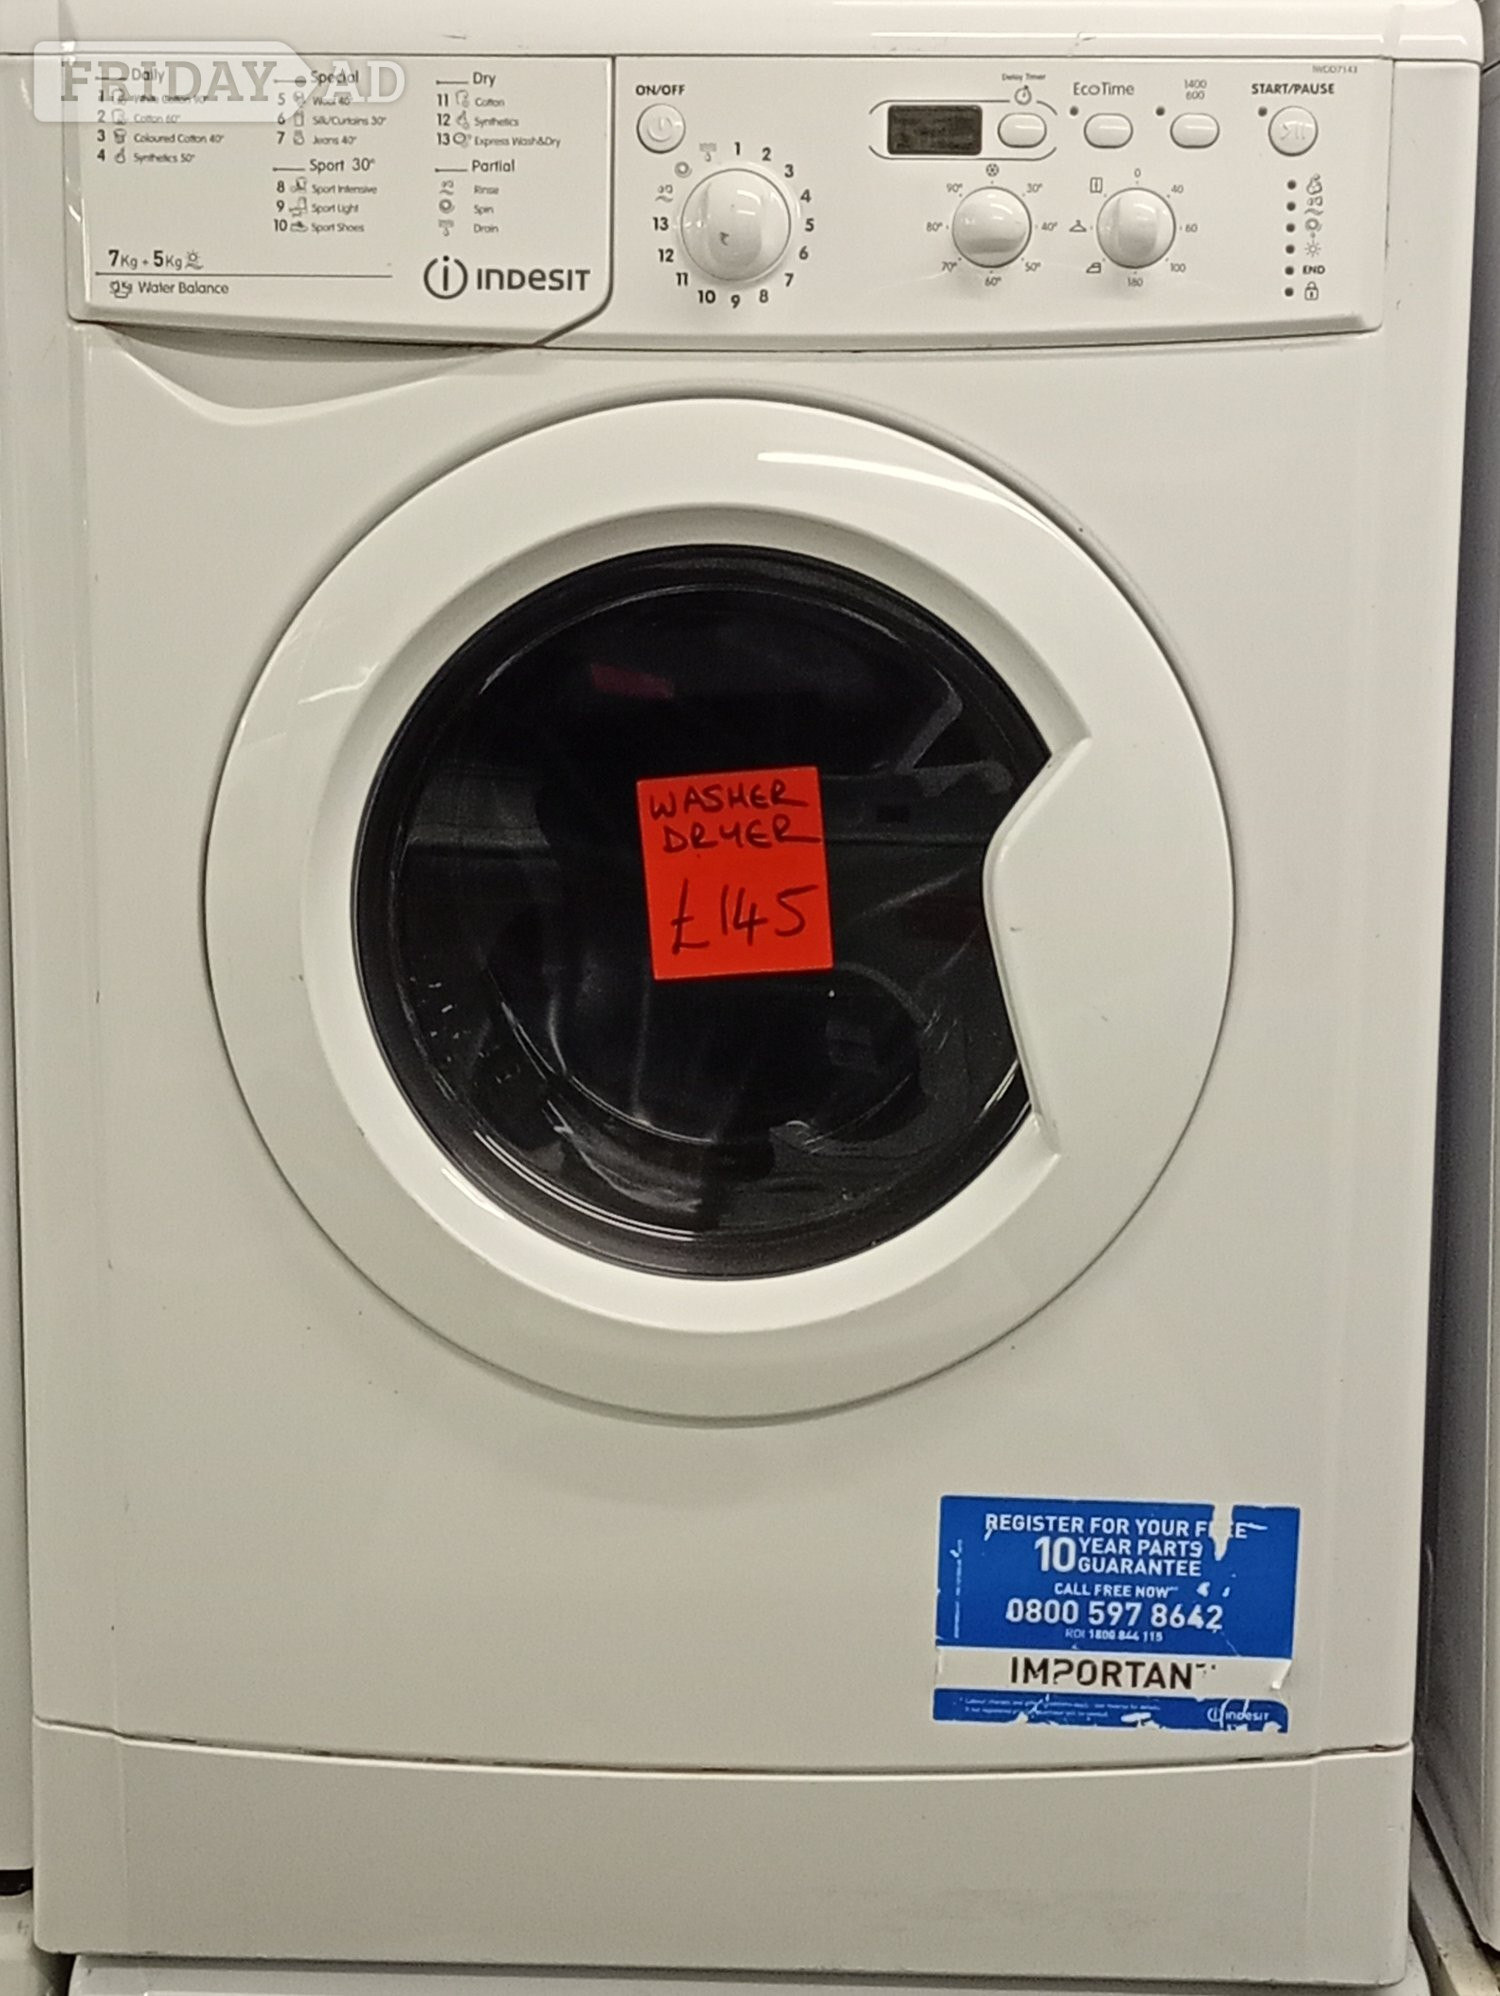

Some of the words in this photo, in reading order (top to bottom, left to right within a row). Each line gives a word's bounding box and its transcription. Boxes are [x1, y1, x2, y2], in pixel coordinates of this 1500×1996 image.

[131, 67, 165, 84] Daily
[310, 70, 359, 85] Special
[473, 71, 496, 88] Dry
[1002, 73, 1023, 81] Delay
[635, 84, 685, 96] ON/OFF
[1073, 81, 1135, 96] EcoTime
[1184, 79, 1207, 89] 1400
[1251, 83, 1335, 95] START/PAUSE
[277, 92, 285, 106] 5
[436, 93, 449, 107] 11
[474, 98, 505, 107] Cotton
[97, 110, 106, 123] 2
[134, 113, 163, 123] Cotton
[277, 112, 286, 125] 6
[436, 113, 450, 127] 12
[474, 117, 519, 128] Synthetics
[97, 129, 105, 142] 3
[133, 133, 175, 143] Coloured
[177, 133, 207, 143] Cotton
[277, 131, 285, 145] 7
[313, 136, 339, 145] Jeans
[436, 132, 450, 145] 13
[474, 136, 510, 148] Express
[734, 142, 741, 156] 1
[762, 147, 772, 162] 2
[97, 149, 105, 161] 4
[133, 153, 178, 165] Synthetics
[309, 158, 345, 174] Sport
[472, 159, 515, 172] Partial
[784, 164, 794, 178] 3
[1134, 168, 1141, 178] 0
[276, 180, 285, 193] 8
[311, 184, 336, 194] Sport
[338, 184, 378, 194] Intensive
[474, 185, 499, 195] Rinse
[1171, 184, 1184, 194] 40
[800, 189, 812, 203] 4
[276, 200, 285, 213] 9
[311, 203, 336, 214] Sport
[337, 203, 359, 215] Light
[474, 204, 494, 216] Spin
[273, 218, 288, 232] 10
[311, 223, 335, 234] Sport
[336, 222, 365, 233] Shoes
[474, 223, 499, 233] Drain
[652, 217, 669, 231] 13
[804, 218, 815, 232] 5
[1185, 223, 1198, 233] 60
[658, 248, 674, 262] 12
[799, 245, 809, 260] 6
[1170, 262, 1186, 273] 100
[1302, 265, 1326, 275] END
[676, 272, 688, 286] 11
[784, 272, 794, 287] 7
[1127, 276, 1143, 287] 180
[138, 281, 175, 294] Water
[178, 281, 229, 294] Balance
[698, 290, 716, 304] 10
[730, 295, 741, 309] 9
[759, 289, 769, 303] 8
[650, 779, 809, 820] WASHER
[663, 813, 822, 853] DRYER
[671, 878, 819, 955] £145
[986, 1514, 1084, 1533] REGISTER
[1090, 1517, 1130, 1535] FOR
[1135, 1519, 1190, 1538] YOUR
[1195, 1521, 1248, 1539] FE
[1034, 1536, 1078, 1573] 10
[1079, 1537, 1131, 1555] YEAR
[1137, 1539, 1204, 1558] PARTS
[1078, 1557, 1202, 1577] GUARANTEE
[1054, 1582, 1091, 1596] CALL
[1094, 1584, 1132, 1598] FREE
[1006, 1598, 1079, 1624] 0800
[1088, 1601, 1143, 1626] 597
[1150, 1603, 1223, 1630] 8642
[1010, 1657, 1216, 1690] IMPORTAN
